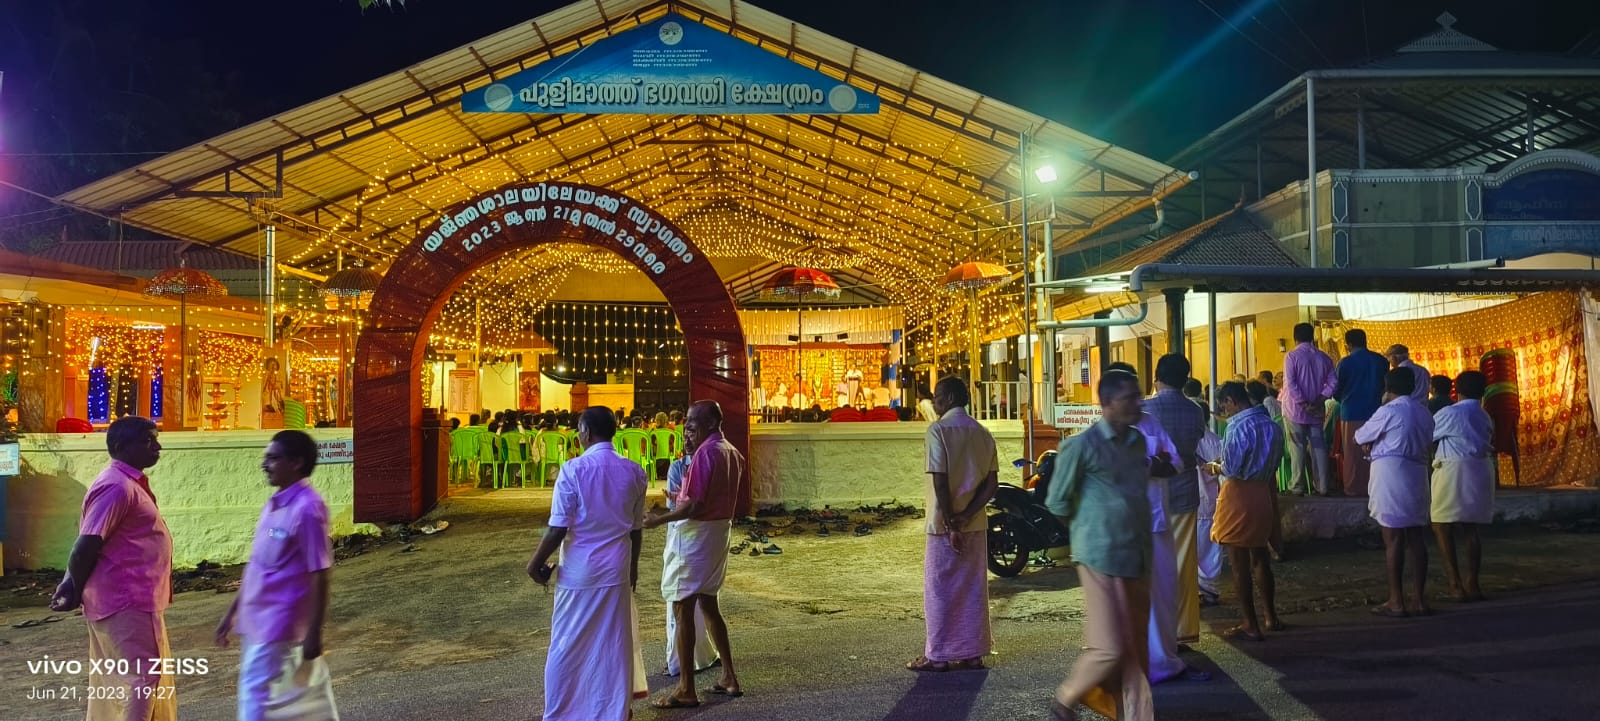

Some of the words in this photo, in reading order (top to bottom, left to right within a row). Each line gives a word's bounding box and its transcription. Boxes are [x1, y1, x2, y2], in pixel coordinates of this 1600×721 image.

[519, 77, 642, 108] പുളിമാത്ത്
[644, 77, 727, 105] ഭഗവതി
[731, 80, 824, 109] ക്ഷേത്രം
[462, 220, 502, 252] 2023
[504, 206, 547, 226] ജൂൺ
[626, 206, 694, 264] സ്വാഗതം
